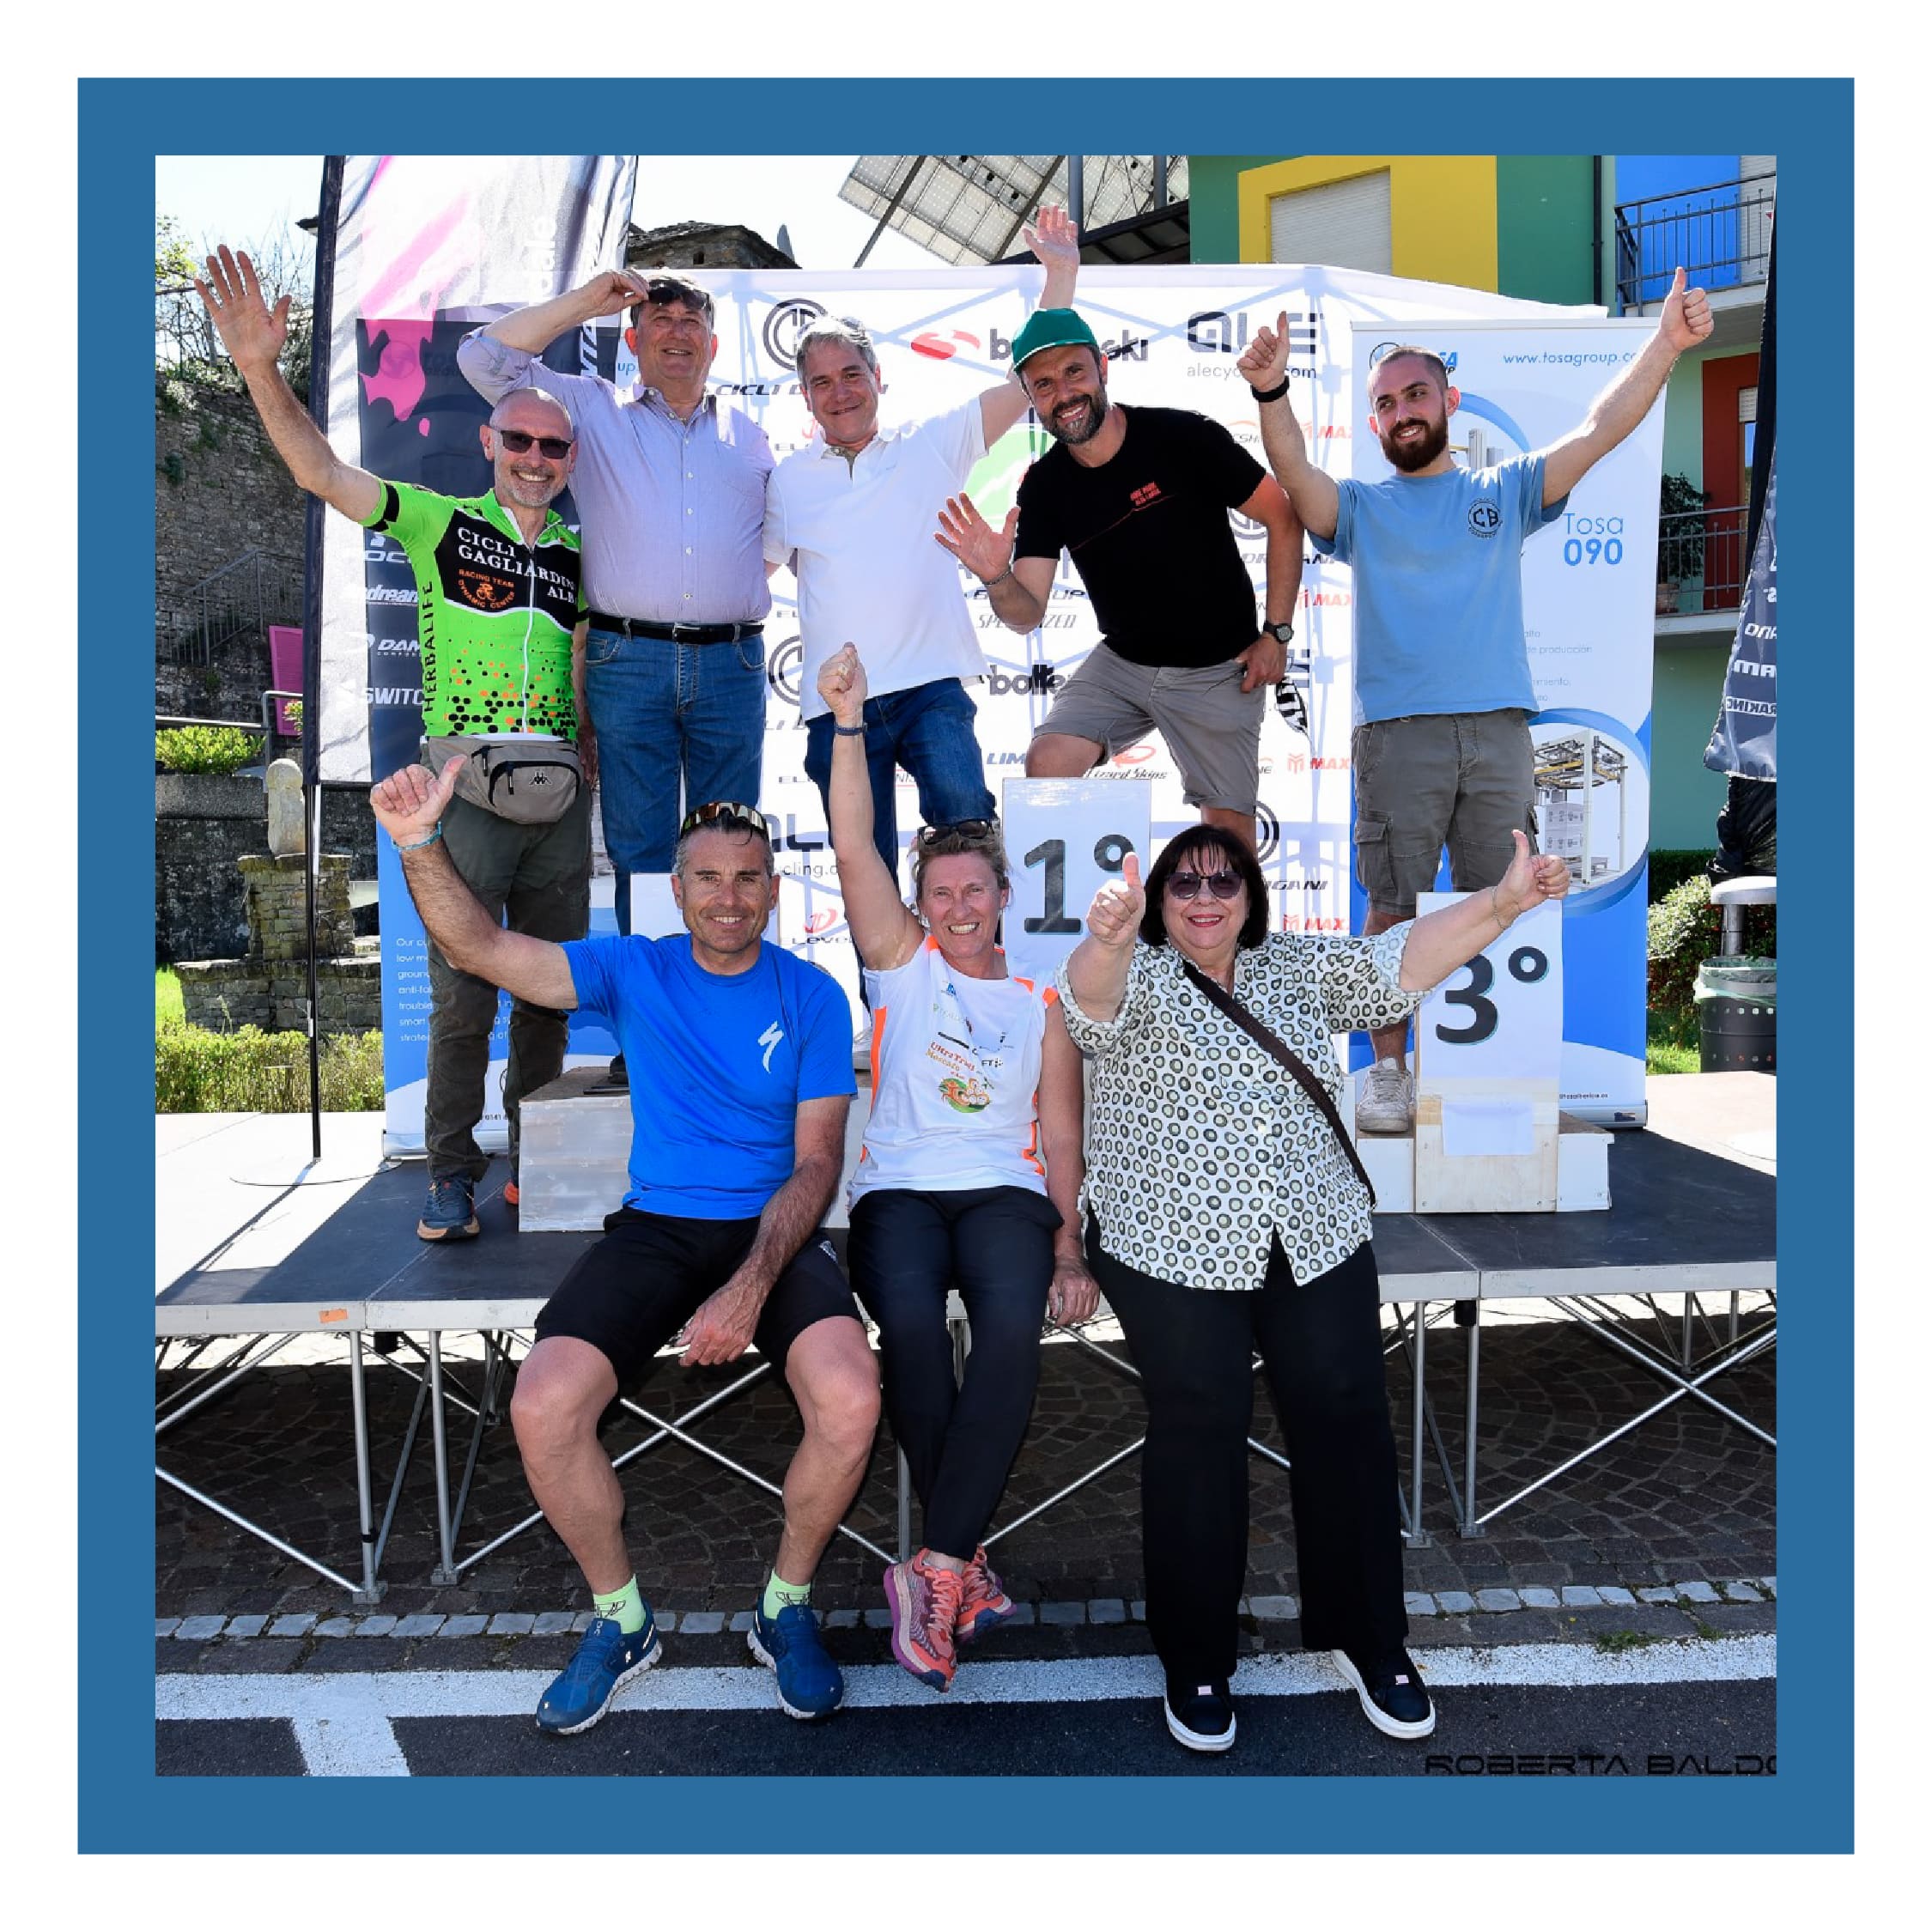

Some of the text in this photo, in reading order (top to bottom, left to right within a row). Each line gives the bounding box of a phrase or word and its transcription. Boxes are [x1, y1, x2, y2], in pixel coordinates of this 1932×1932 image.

[1563, 513, 1624, 535] Tosa
[1564, 538, 1624, 567] 090
[422, 580, 437, 712] HERBALIFE
